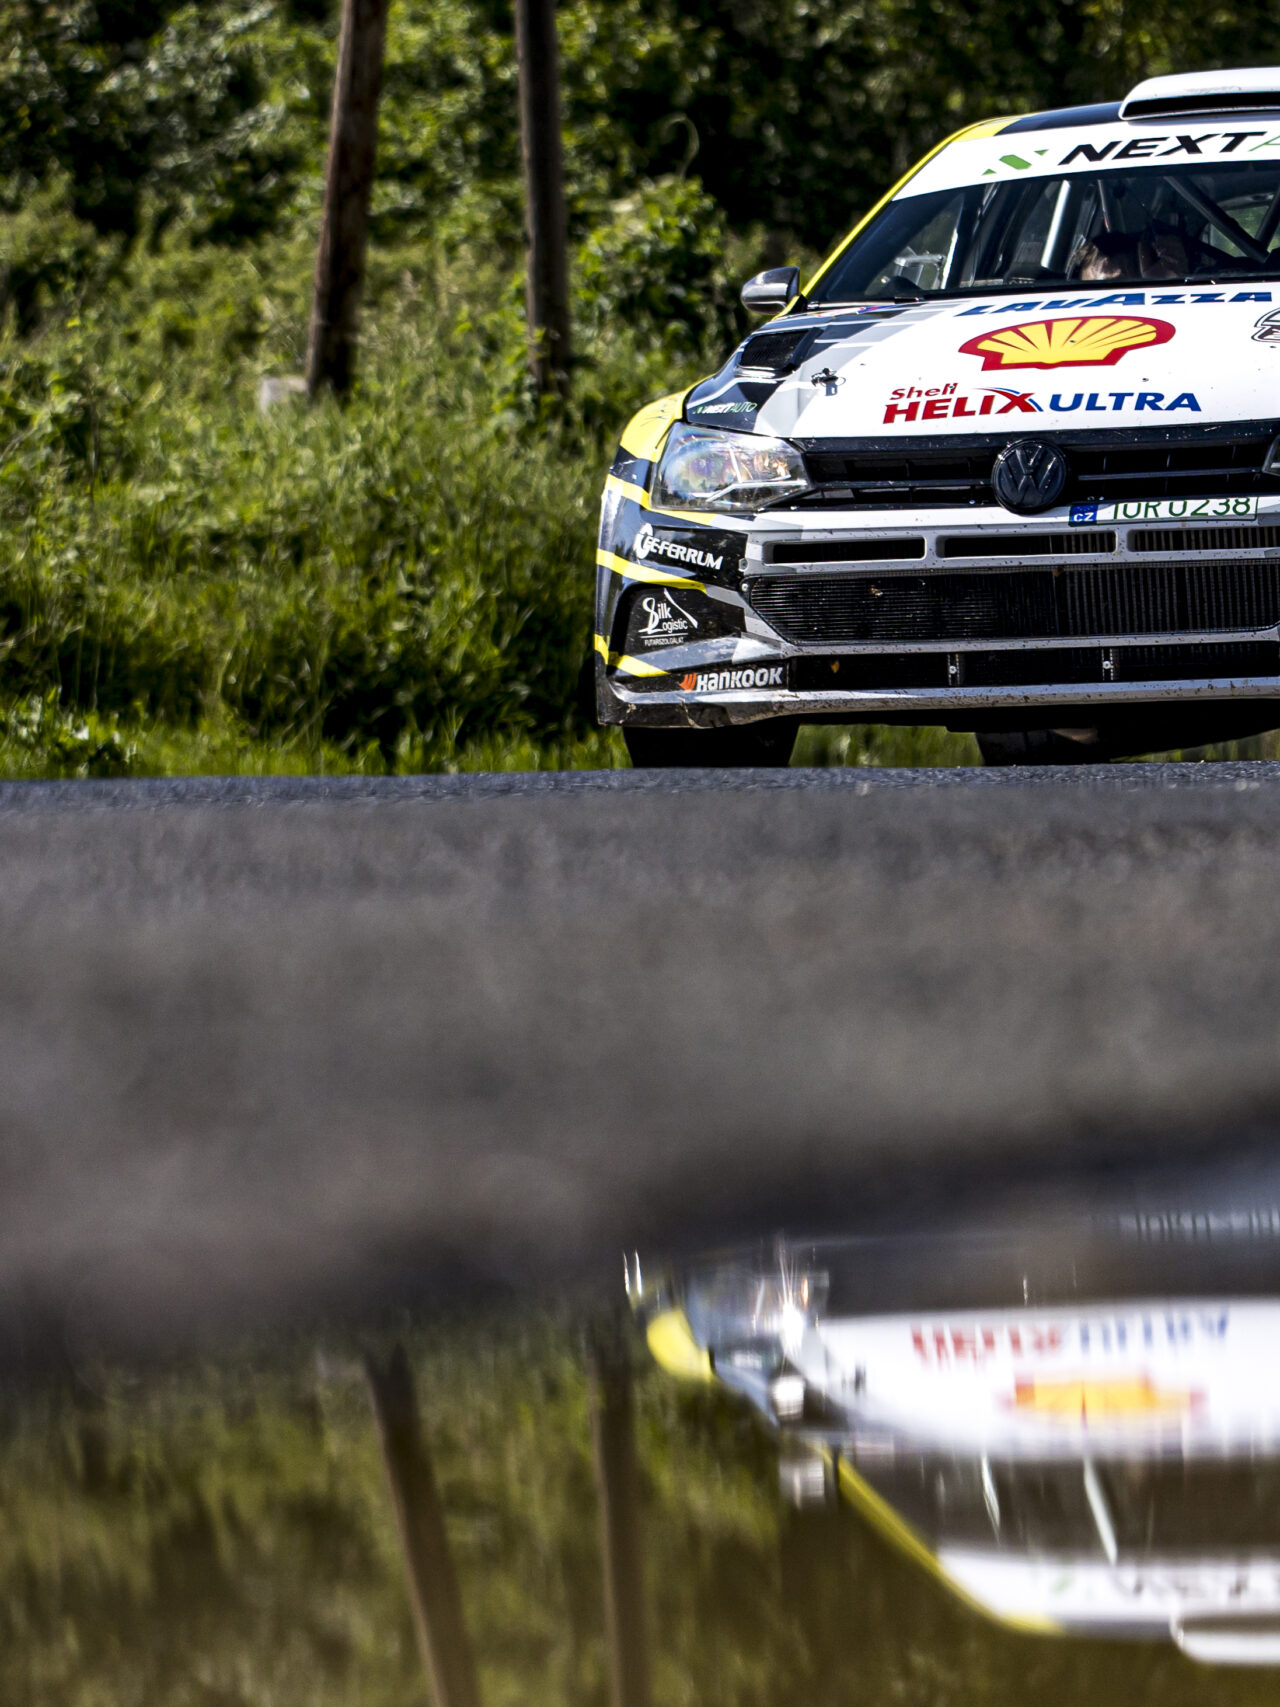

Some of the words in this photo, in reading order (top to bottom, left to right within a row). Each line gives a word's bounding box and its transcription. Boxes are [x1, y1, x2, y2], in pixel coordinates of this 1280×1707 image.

[955, 291, 1273, 316] LAVAZZA
[890, 383, 957, 401] Shell
[882, 390, 1038, 424] HELIX
[1049, 392, 1202, 412] ULTRA
[1073, 511, 1094, 522] CZ
[643, 597, 672, 624] Silk
